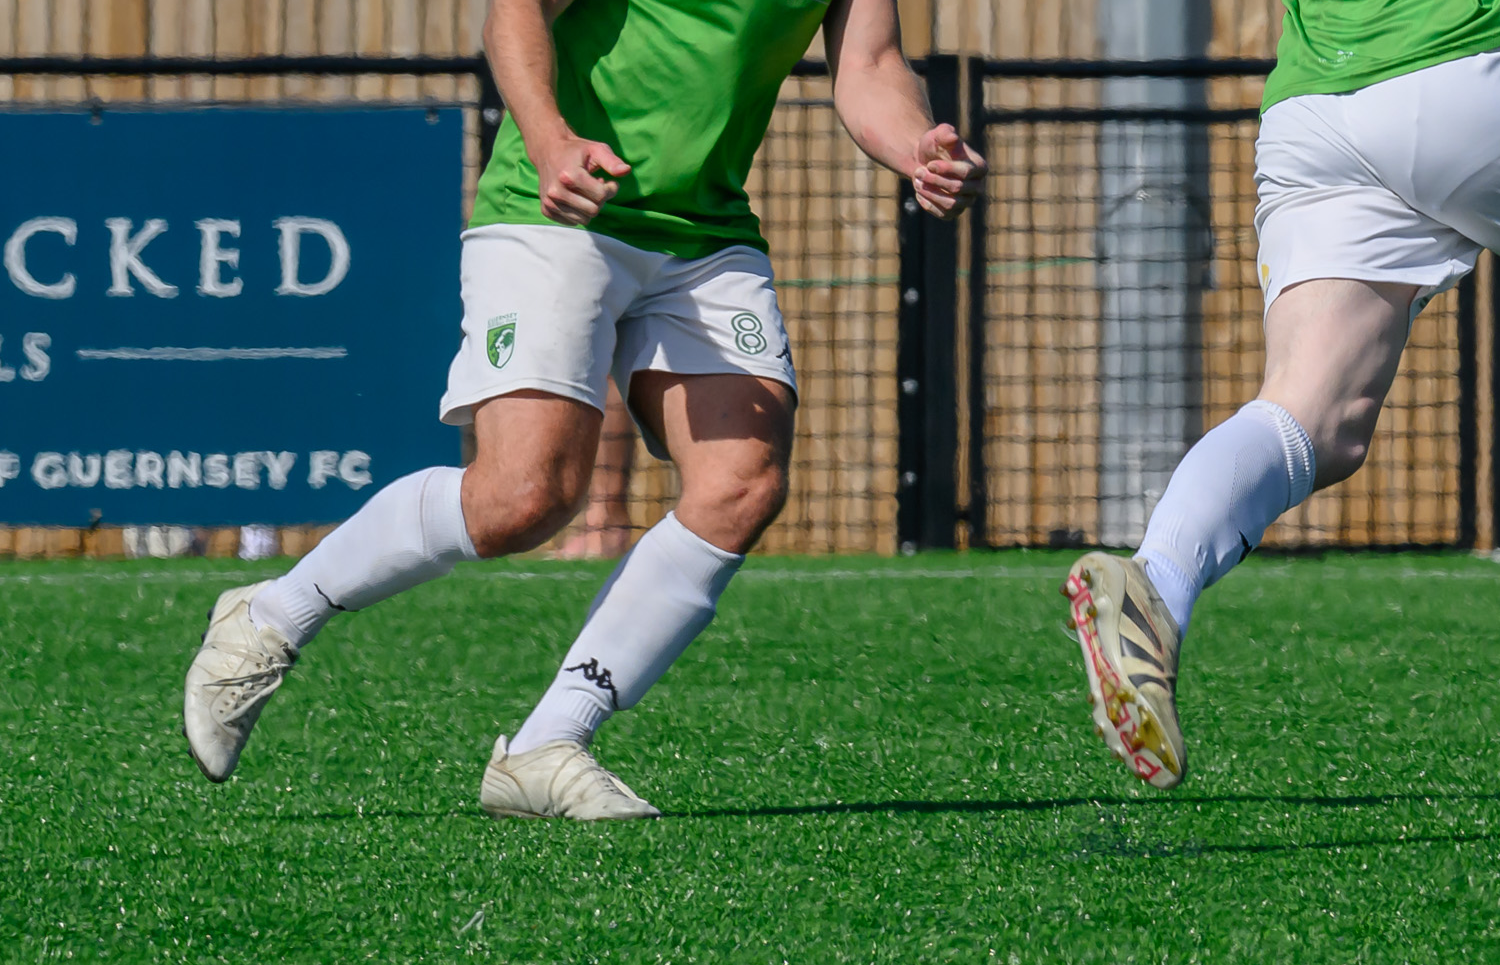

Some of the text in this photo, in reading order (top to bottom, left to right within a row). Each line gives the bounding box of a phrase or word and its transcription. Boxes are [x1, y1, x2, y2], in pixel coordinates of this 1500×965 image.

[731, 312, 767, 355] 8
[31, 448, 297, 490] GUERNSEY
[307, 449, 373, 490] FC
